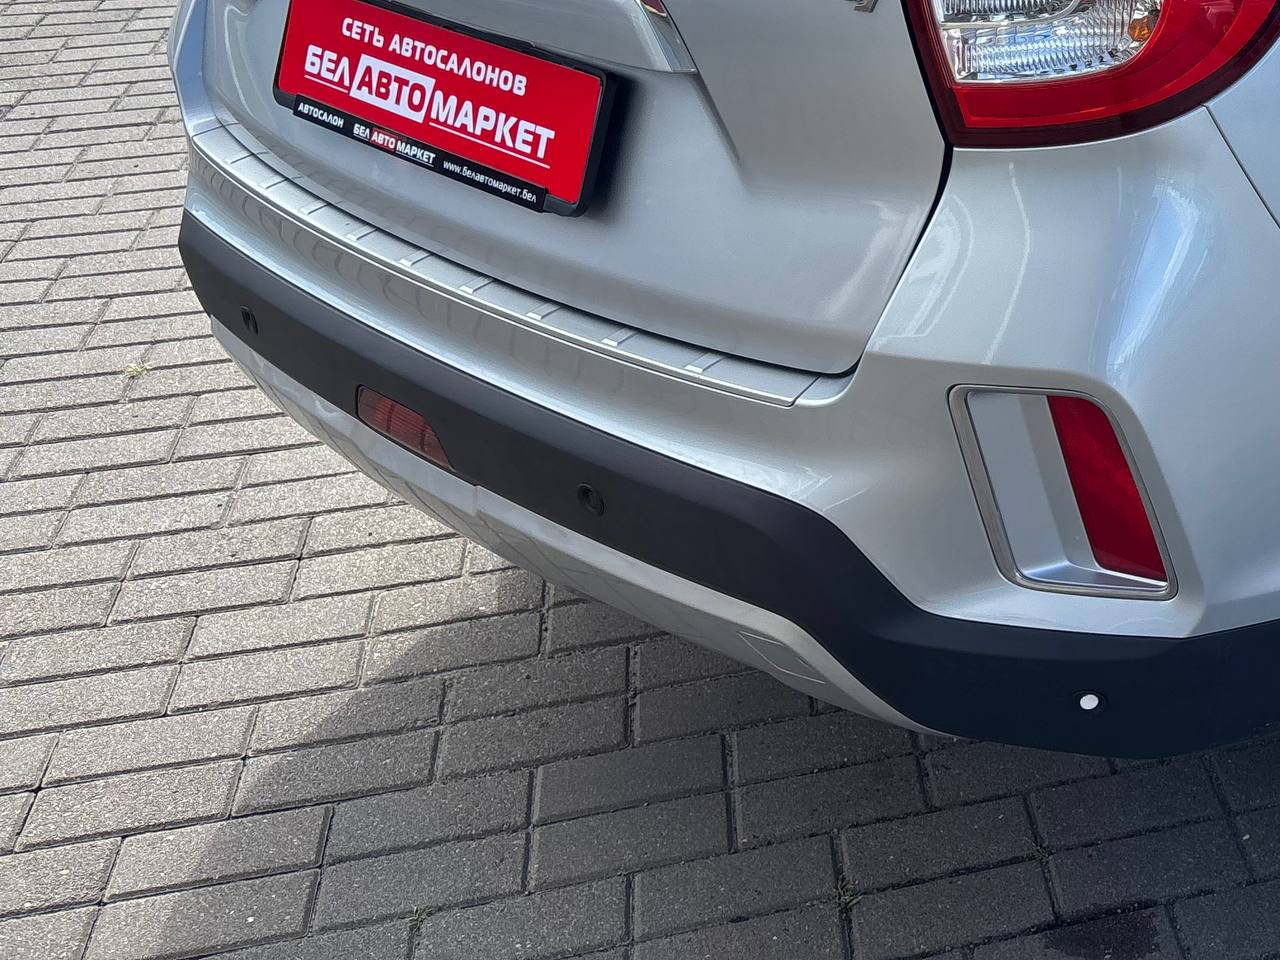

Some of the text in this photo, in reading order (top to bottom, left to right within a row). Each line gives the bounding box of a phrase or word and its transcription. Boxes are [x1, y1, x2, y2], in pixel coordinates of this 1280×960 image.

[341, 17, 528, 96] СЕТЬ АВТОСАЛОНОВ
[297, 101, 344, 129] АВТОСАЛОН
[442, 159, 538, 204] www.белавтомаркет.бел
